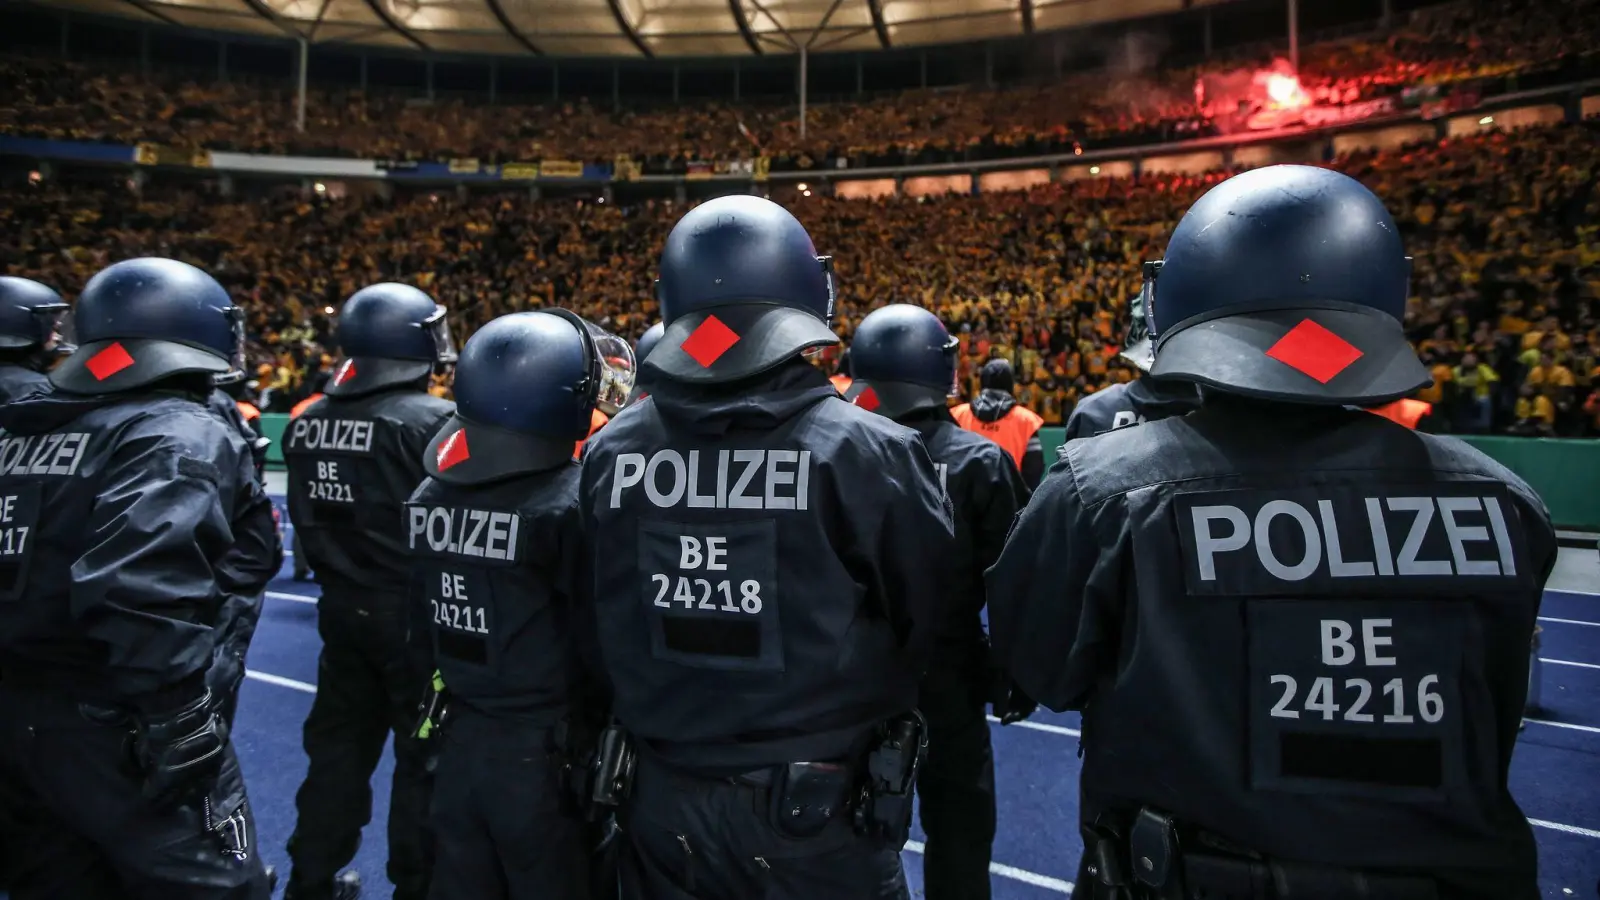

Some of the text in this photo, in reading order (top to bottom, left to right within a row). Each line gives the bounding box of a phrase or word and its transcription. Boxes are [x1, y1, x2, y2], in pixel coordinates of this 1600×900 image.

[289, 418, 374, 452] POLIZEI
[317, 461, 339, 481] BE
[610, 449, 811, 511] POLIZEI
[308, 481, 355, 502] 24221
[409, 506, 519, 561] POLIZEI
[679, 535, 728, 571] BE
[1190, 496, 1517, 581] POLIZEI
[441, 571, 469, 600] BE
[652, 573, 763, 615] 24218
[430, 599, 489, 634] 24211
[1320, 618, 1397, 666] BE
[1270, 673, 1445, 723] 24216
